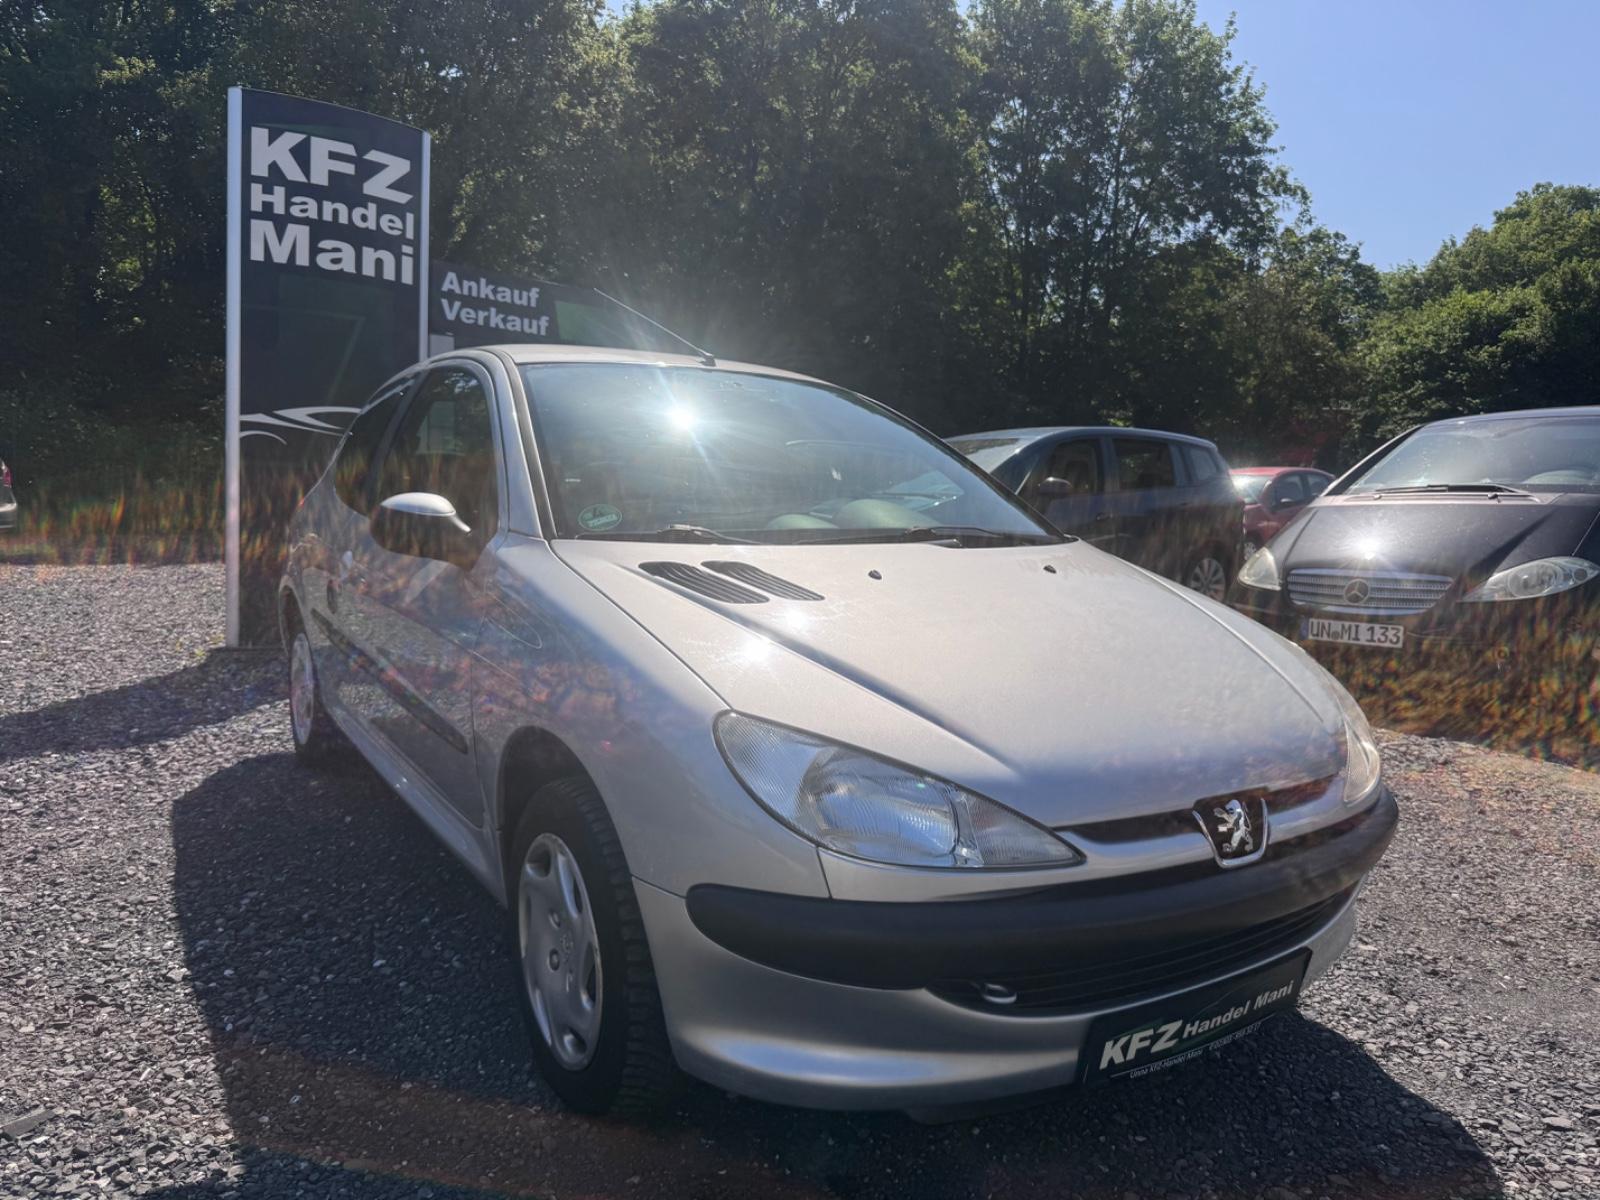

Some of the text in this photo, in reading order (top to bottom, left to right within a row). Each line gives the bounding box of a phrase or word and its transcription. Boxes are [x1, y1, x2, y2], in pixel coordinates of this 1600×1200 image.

[250, 126, 413, 204] KFZ
[250, 183, 414, 240] Handel
[250, 218, 414, 285] Mani
[441, 271, 540, 308] Ankauf
[441, 298, 549, 336] Verkauf
[1310, 621, 1401, 645] UN MI 133
[1099, 1019, 1183, 1070] KFZ
[1182, 1001, 1249, 1039] Handel
[1253, 980, 1294, 1011] Mani
